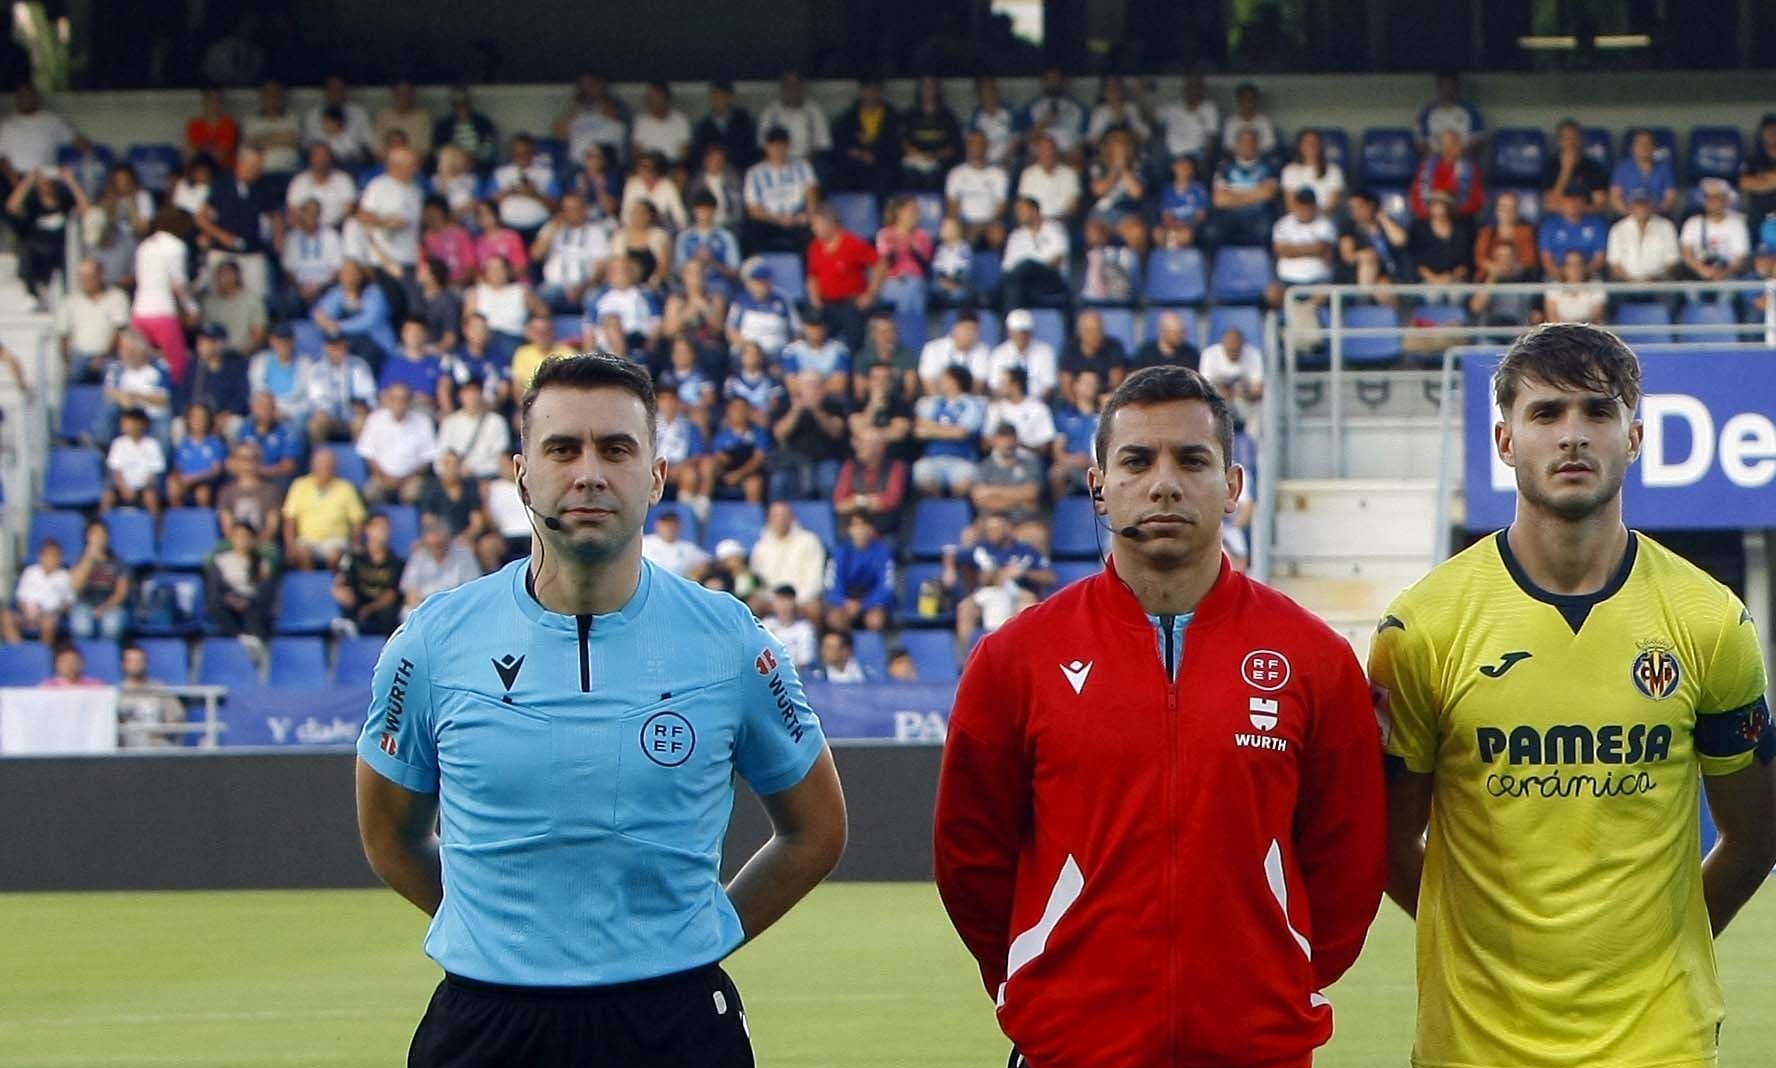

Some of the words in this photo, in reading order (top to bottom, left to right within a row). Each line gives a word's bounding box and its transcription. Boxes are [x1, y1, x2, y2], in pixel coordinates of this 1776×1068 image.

[769, 672, 805, 744] WÜRTH
[1476, 724, 1674, 765] PAMESA
[1486, 769, 1658, 798] cerámica
